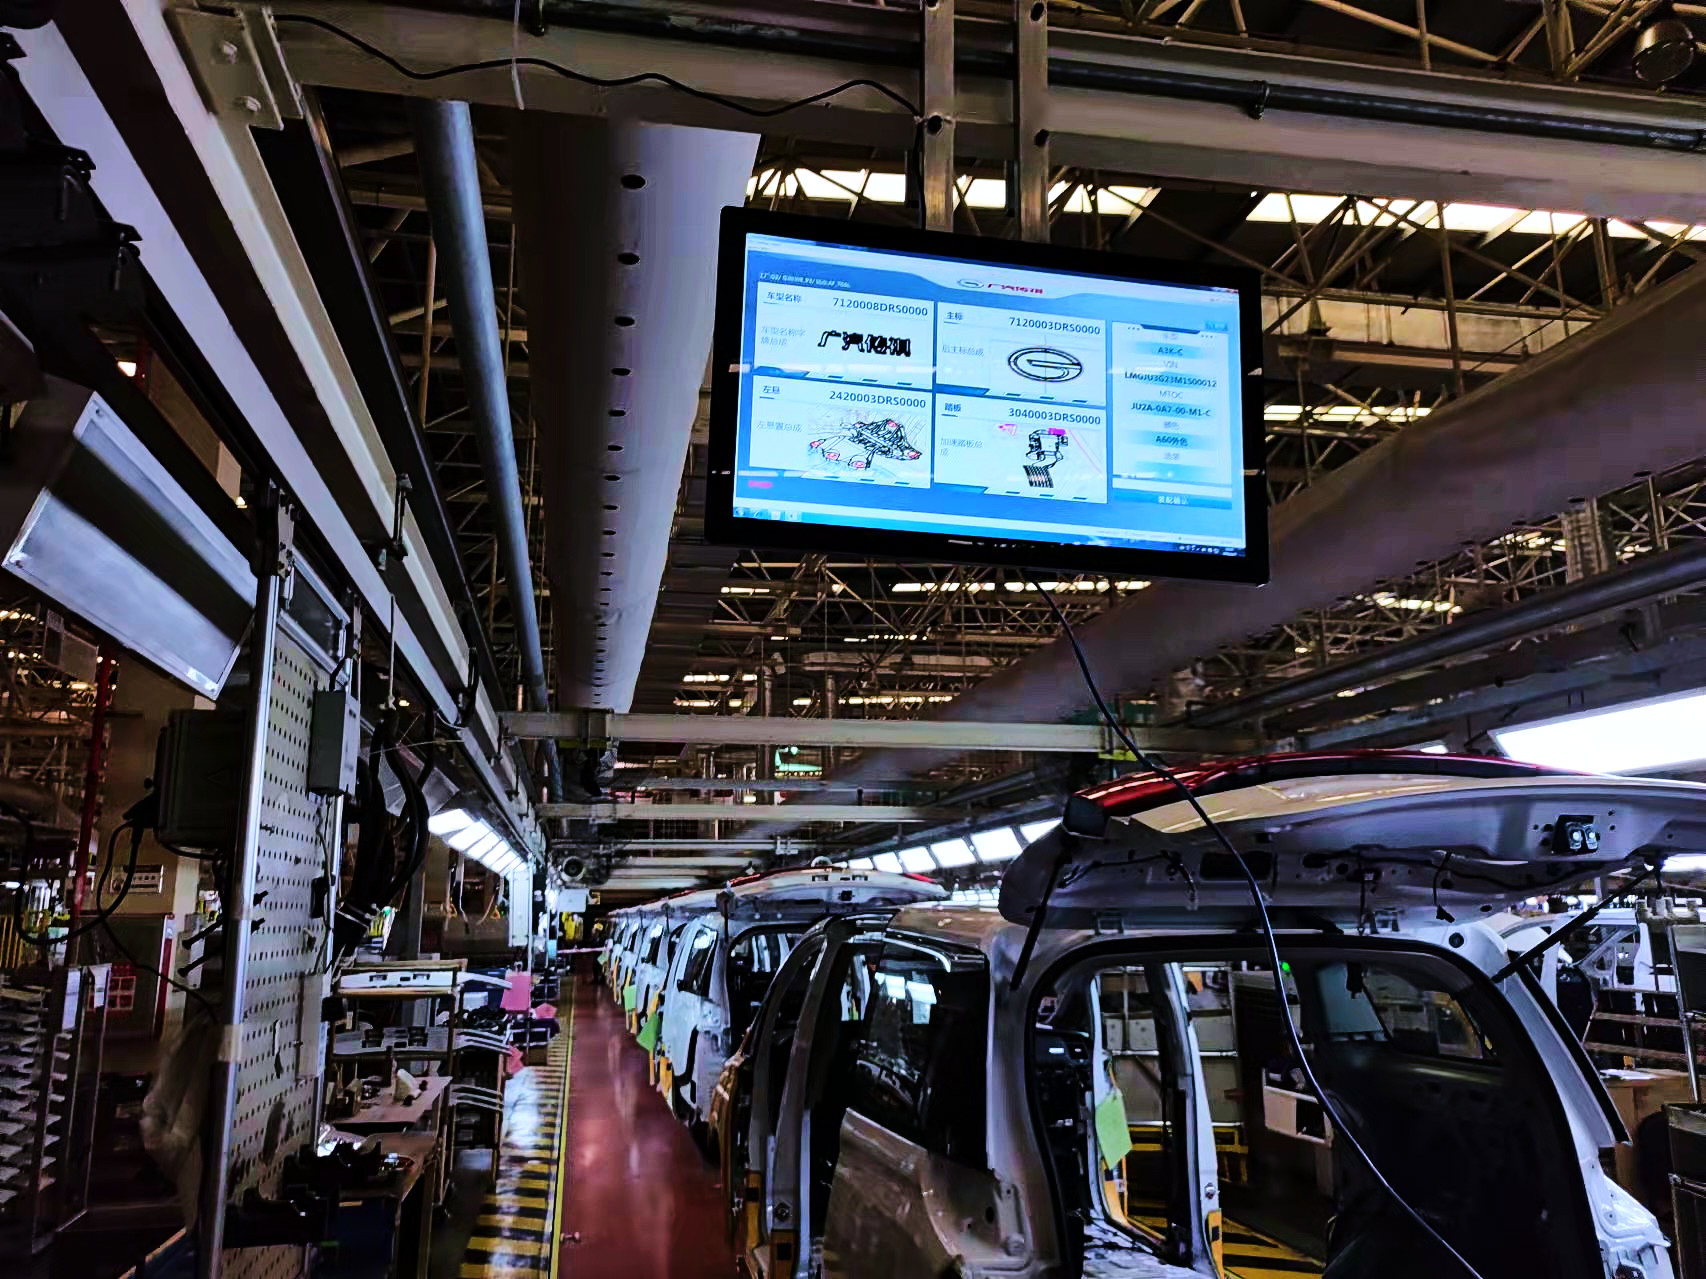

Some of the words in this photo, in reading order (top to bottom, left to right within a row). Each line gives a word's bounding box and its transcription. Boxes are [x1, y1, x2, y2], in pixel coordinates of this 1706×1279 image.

[766, 291, 801, 303] 车型名称
[833, 296, 928, 316] 7120008DRS0000
[1009, 317, 1100, 335] 7120003DRS0000
[829, 390, 927, 409] 2420003DRS0000
[1008, 408, 1101, 425] 3040003DRS0000
